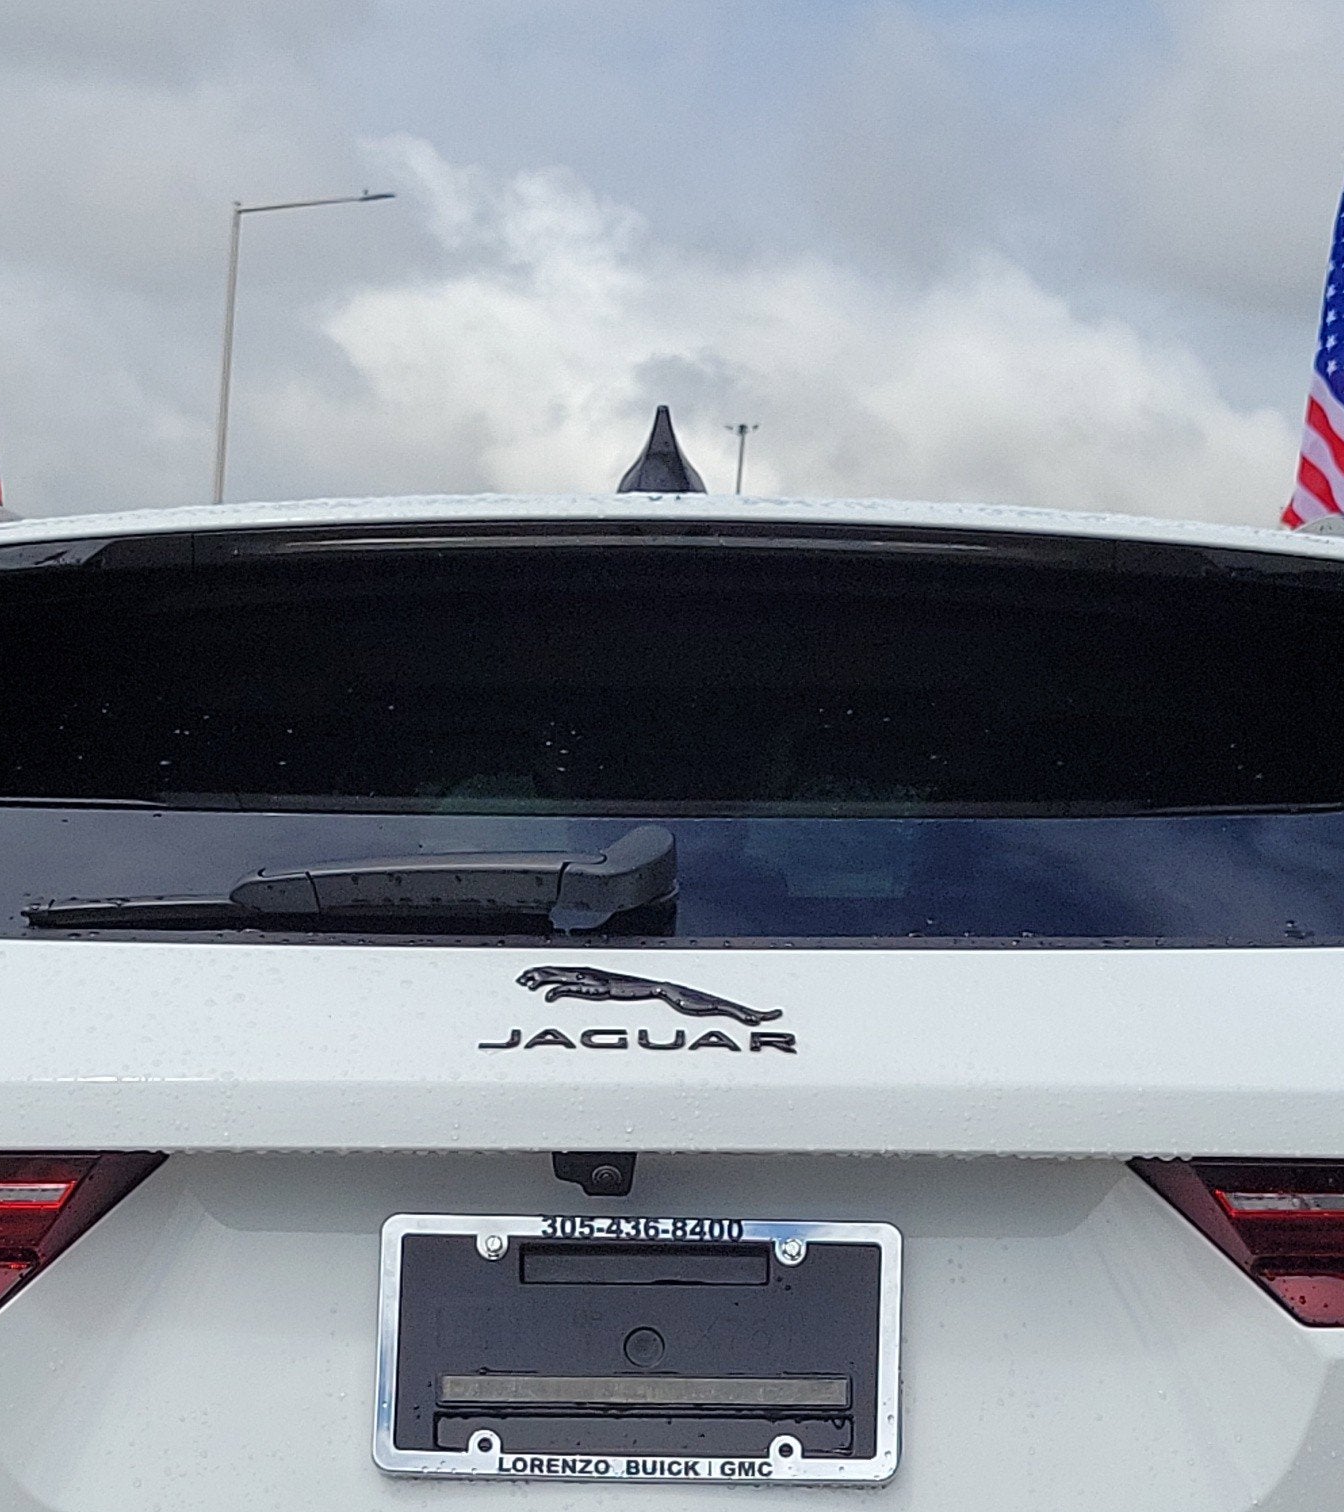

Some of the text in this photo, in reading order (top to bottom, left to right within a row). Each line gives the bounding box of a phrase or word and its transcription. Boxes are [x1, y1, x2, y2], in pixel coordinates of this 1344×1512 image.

[478, 1029, 797, 1054] JAGUAR
[541, 1215, 745, 1242] 305-436-8400
[497, 1456, 774, 1478] LORENZO BUICK GMC
